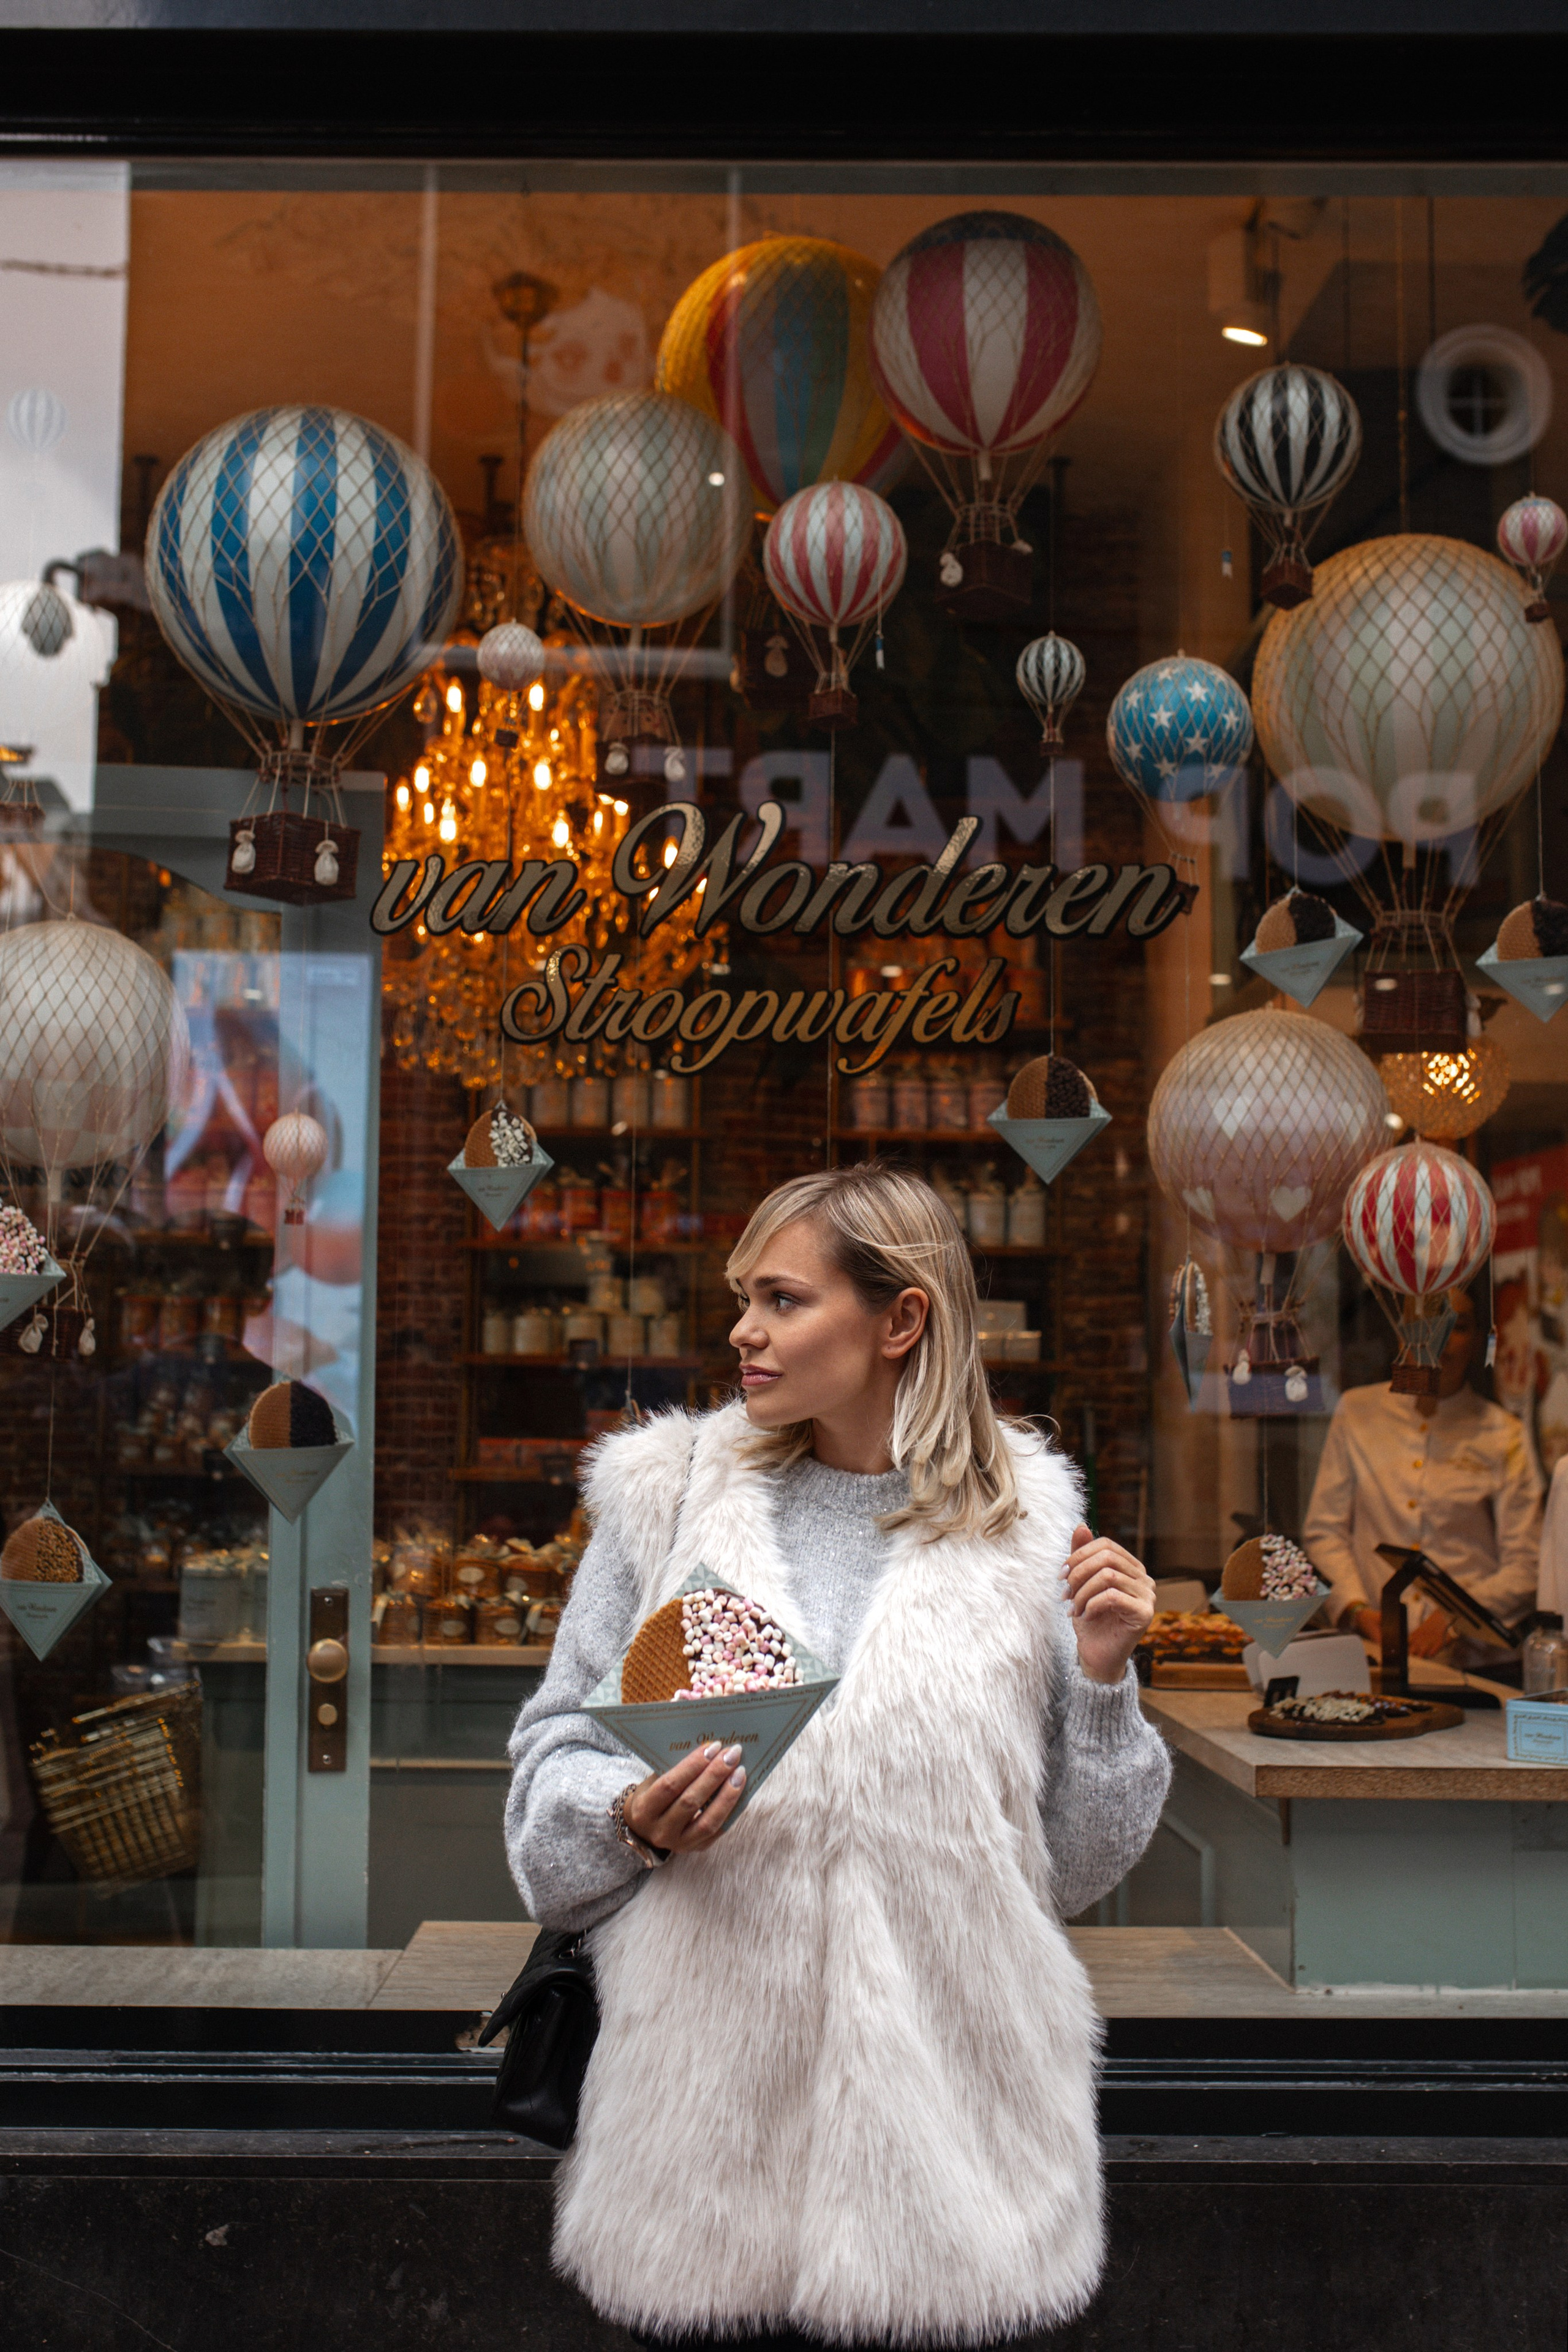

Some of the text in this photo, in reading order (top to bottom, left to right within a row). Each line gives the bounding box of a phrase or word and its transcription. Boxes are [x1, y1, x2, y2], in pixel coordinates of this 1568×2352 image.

[370, 801, 1186, 940] van Wonderen
[501, 943, 1022, 1076] Stroopwafels
[669, 1730, 760, 1752] van Wnderen
